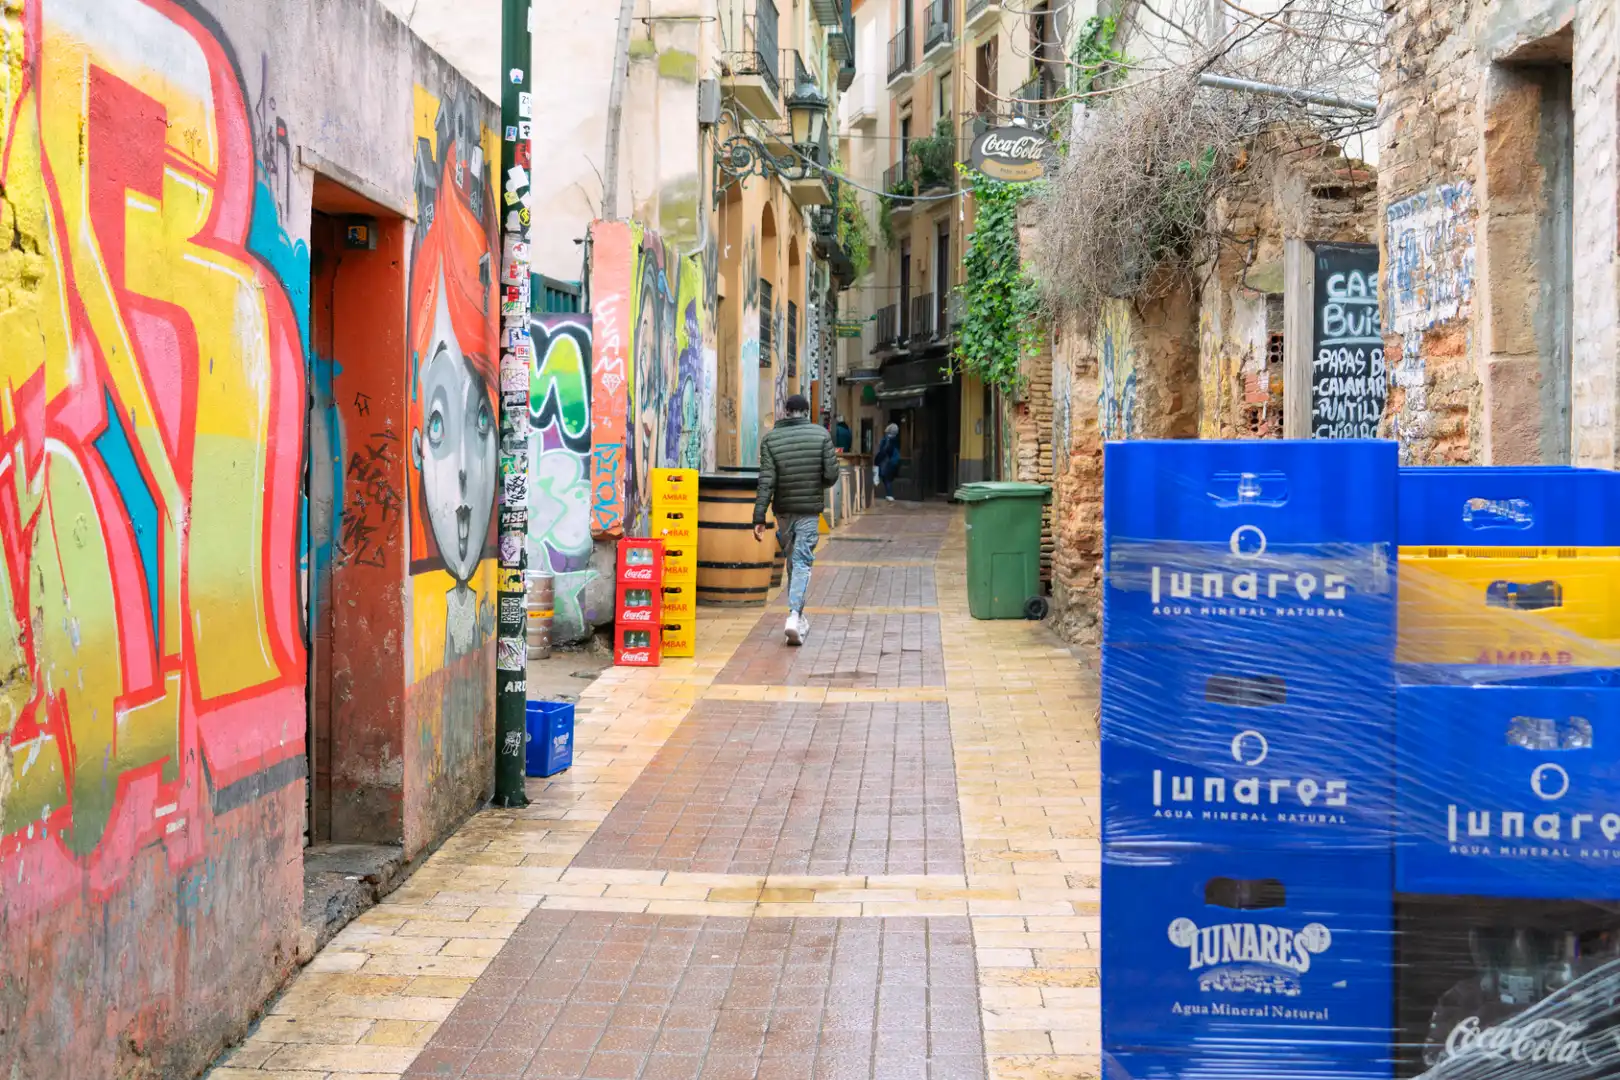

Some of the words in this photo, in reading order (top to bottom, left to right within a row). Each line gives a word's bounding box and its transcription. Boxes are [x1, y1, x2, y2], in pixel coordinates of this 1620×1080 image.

[662, 493, 688, 501] AMBAR
[664, 566, 688, 574] MBAR
[663, 603, 688, 612] MBAR
[1152, 606, 1192, 616] AGUA
[1201, 607, 1267, 617] MINERAL
[1276, 607, 1345, 618] NATURAL
[1153, 809, 1193, 819] AGUA
[1202, 811, 1268, 822] MINERAL
[1278, 813, 1346, 825] NATURAL
[1449, 845, 1491, 856] AGUA
[1500, 846, 1571, 857] MINERAL
[1188, 923, 1311, 974] LUNARES
[1171, 1001, 1209, 1017] Agua
[1211, 1002, 1269, 1018] Mineral
[1272, 1005, 1329, 1021] Natural
